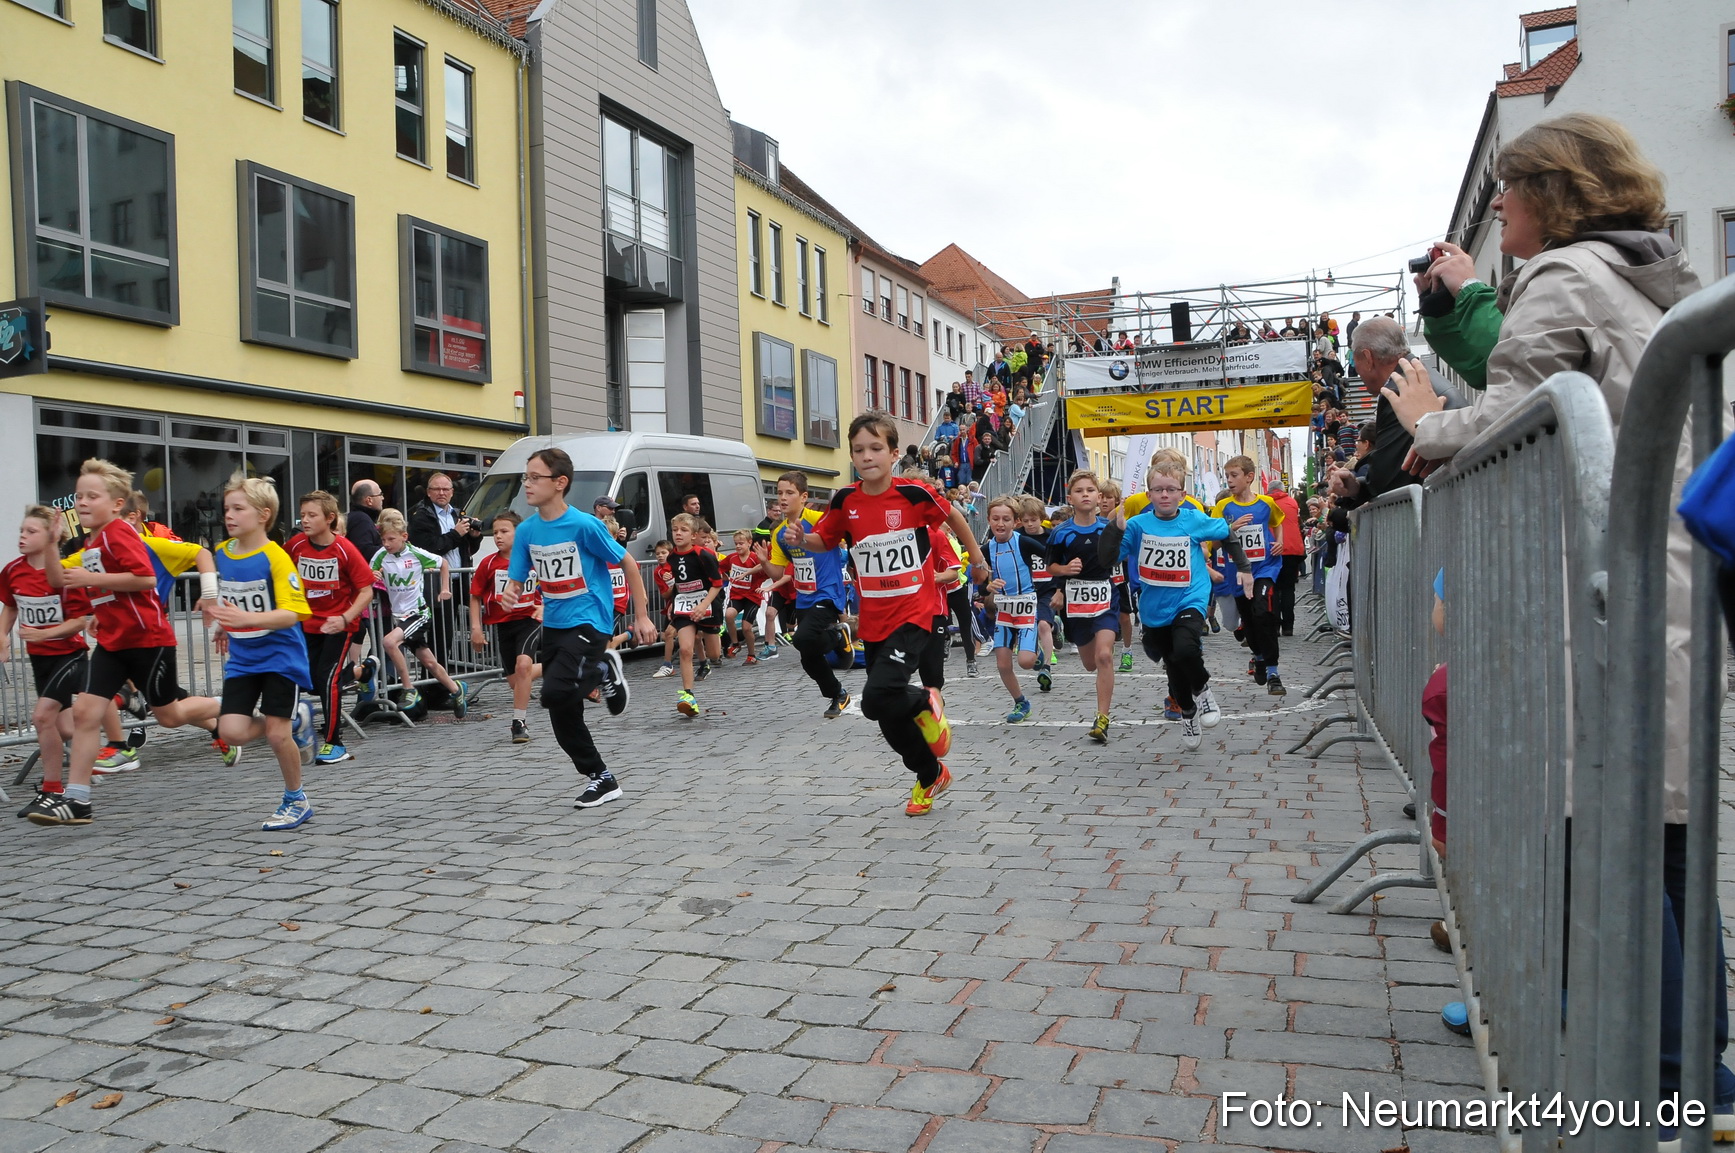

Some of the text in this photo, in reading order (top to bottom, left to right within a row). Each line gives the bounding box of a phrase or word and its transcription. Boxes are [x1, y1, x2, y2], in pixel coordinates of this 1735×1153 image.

[1164, 352, 1260, 368] EfficientDynamics
[1164, 368, 1200, 376] Verbrauch.
[1145, 394, 1229, 418] START
[1133, 462, 1142, 480] BKK
[854, 536, 906, 550] ARTL Neumarkt
[1238, 534, 1262, 548] 164
[858, 544, 914, 574] 7120
[1032, 559, 1045, 570] 53
[1144, 547, 1186, 568] 7238
[301, 563, 334, 580] 7067
[535, 556, 574, 579] 7127
[678, 564, 687, 581] 3
[880, 579, 900, 589] Nico
[1150, 571, 1176, 581] Philipp
[500, 579, 533, 592] 70
[1070, 586, 1108, 602] 7598
[679, 599, 705, 611] 751
